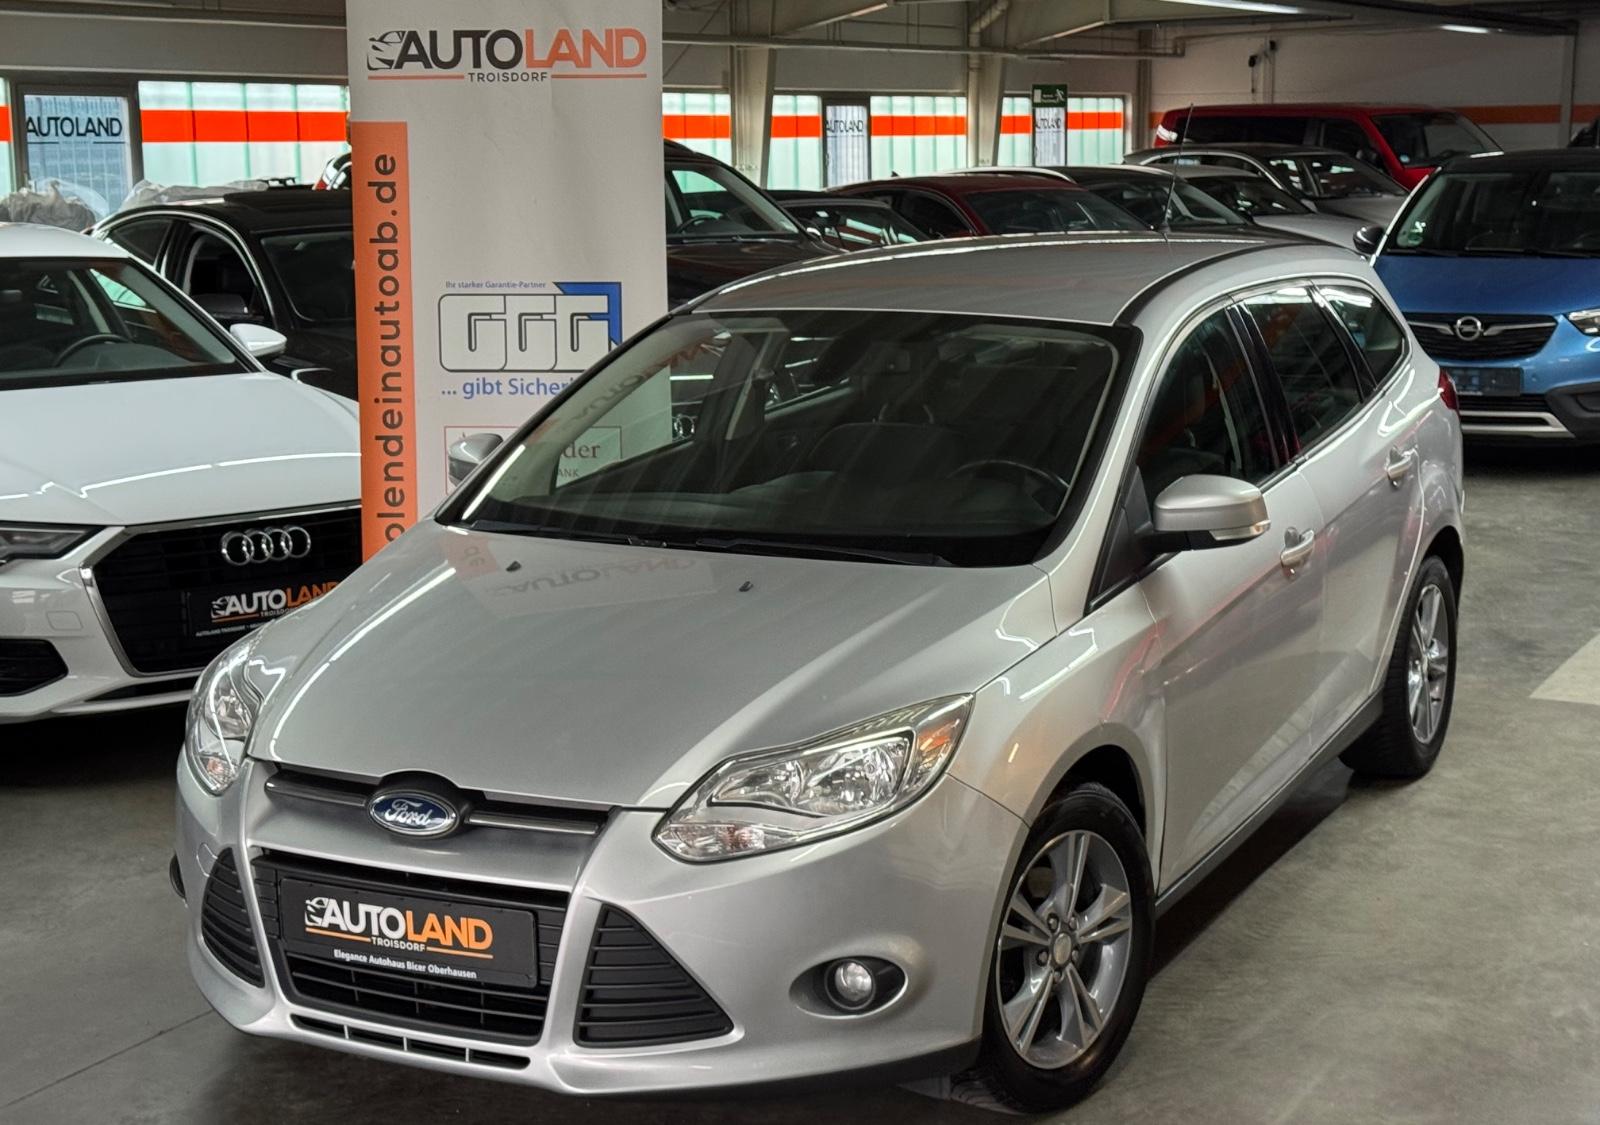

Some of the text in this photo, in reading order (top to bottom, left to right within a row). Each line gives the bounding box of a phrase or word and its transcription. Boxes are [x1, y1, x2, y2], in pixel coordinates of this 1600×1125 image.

[394, 29, 647, 70] AUTOLAND
[467, 71, 548, 83] TROISDORF
[26, 116, 123, 137] AUTOLAND
[446, 281, 547, 289] Ihr starker Garantie-Partner
[462, 377, 503, 400] gibt
[384, 798, 433, 826] Ford
[321, 898, 494, 950] AUTOLAND
[371, 936, 426, 952] TROISDORF
[333, 949, 477, 979] Elegance Autohaus Bicer Oberhausen
